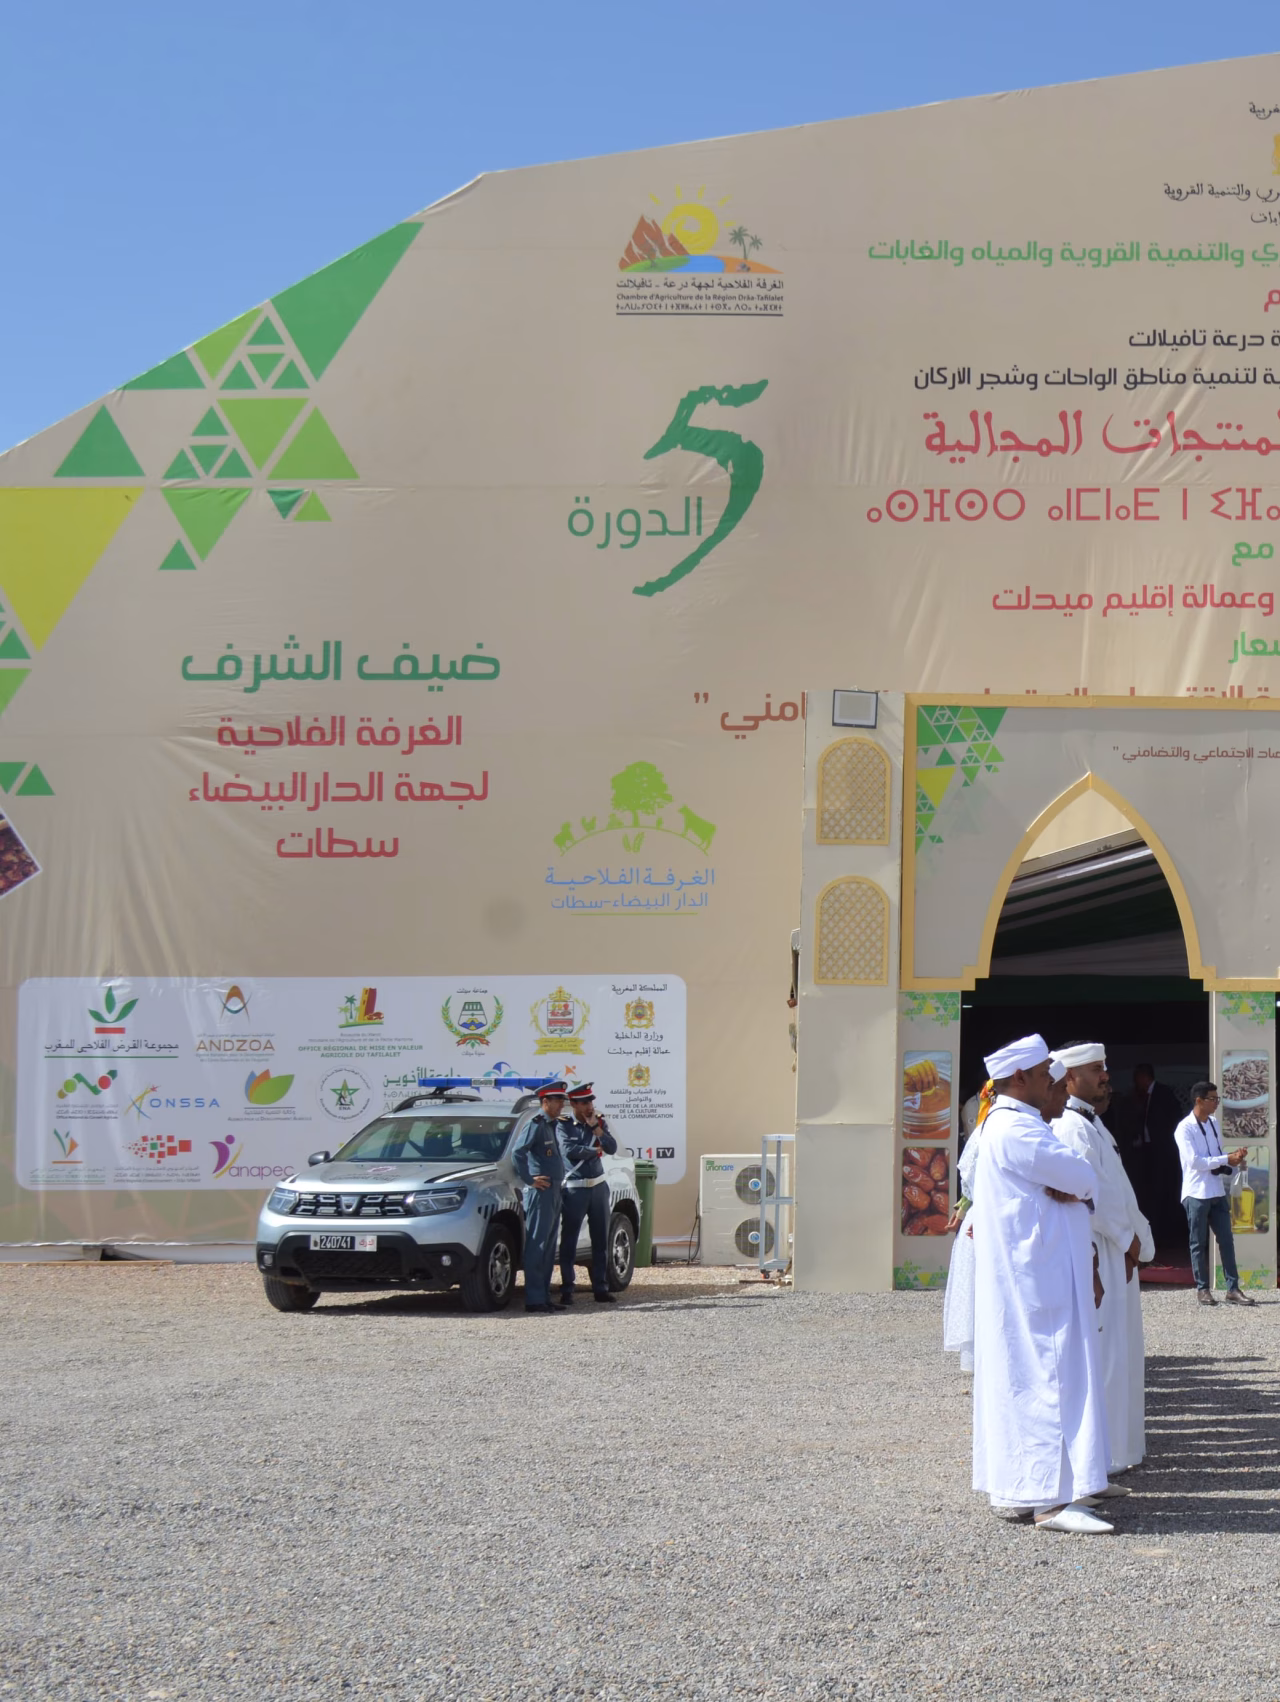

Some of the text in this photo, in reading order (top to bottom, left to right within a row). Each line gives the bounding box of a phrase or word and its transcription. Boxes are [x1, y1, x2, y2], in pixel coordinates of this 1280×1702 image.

[1164, 183, 1204, 201] القروية
[1208, 184, 1251, 201] والتنمية
[868, 239, 964, 266] والغابات
[971, 240, 1053, 267] والمياه
[1060, 241, 1140, 268] القروية
[1148, 242, 1244, 268] والتنمية
[616, 279, 653, 291] تافيلالت
[691, 279, 714, 291] لجهة
[718, 279, 752, 291] الفلاحية
[756, 280, 784, 292] الغرفة
[649, 294, 694, 302] d'Agriculture
[713, 294, 737, 302] Région
[1129, 329, 1207, 351] تافيلالت
[1212, 329, 1264, 351] درعة
[976, 365, 1039, 390] وشجر
[1044, 366, 1117, 390] الواحات
[1123, 367, 1187, 390] مناطق
[1192, 367, 1257, 390] لتنمية
[923, 409, 1084, 464] المجالية
[568, 496, 702, 549] الدورة
[1231, 541, 1275, 567] مع
[992, 584, 1093, 617] ميدلت
[1102, 583, 1174, 617] إقليم
[1182, 583, 1274, 616] وعمالة
[181, 634, 501, 693] ضيف الشرف
[217, 715, 462, 755] الغرفة الفلاحية
[1122, 746, 1190, 763] والتضامني
[1193, 747, 1254, 763] الاجتماعي
[395, 771, 489, 810] لجهة
[276, 827, 399, 858] سطات
[545, 867, 715, 891] الغرفة الفلاحية
[675, 892, 708, 911] الدار
[611, 984, 668, 995] المملكة المغربية
[44, 1039, 179, 1053] مجموعة القرض الفلاحي للمغرب
[196, 1039, 275, 1052] ANDZOA
[615, 1031, 664, 1042] وزارة الداخلية
[150, 1098, 221, 1108] ONSSA
[646, 1147, 673, 1159] 1 TV
[229, 1165, 295, 1181] anapec
